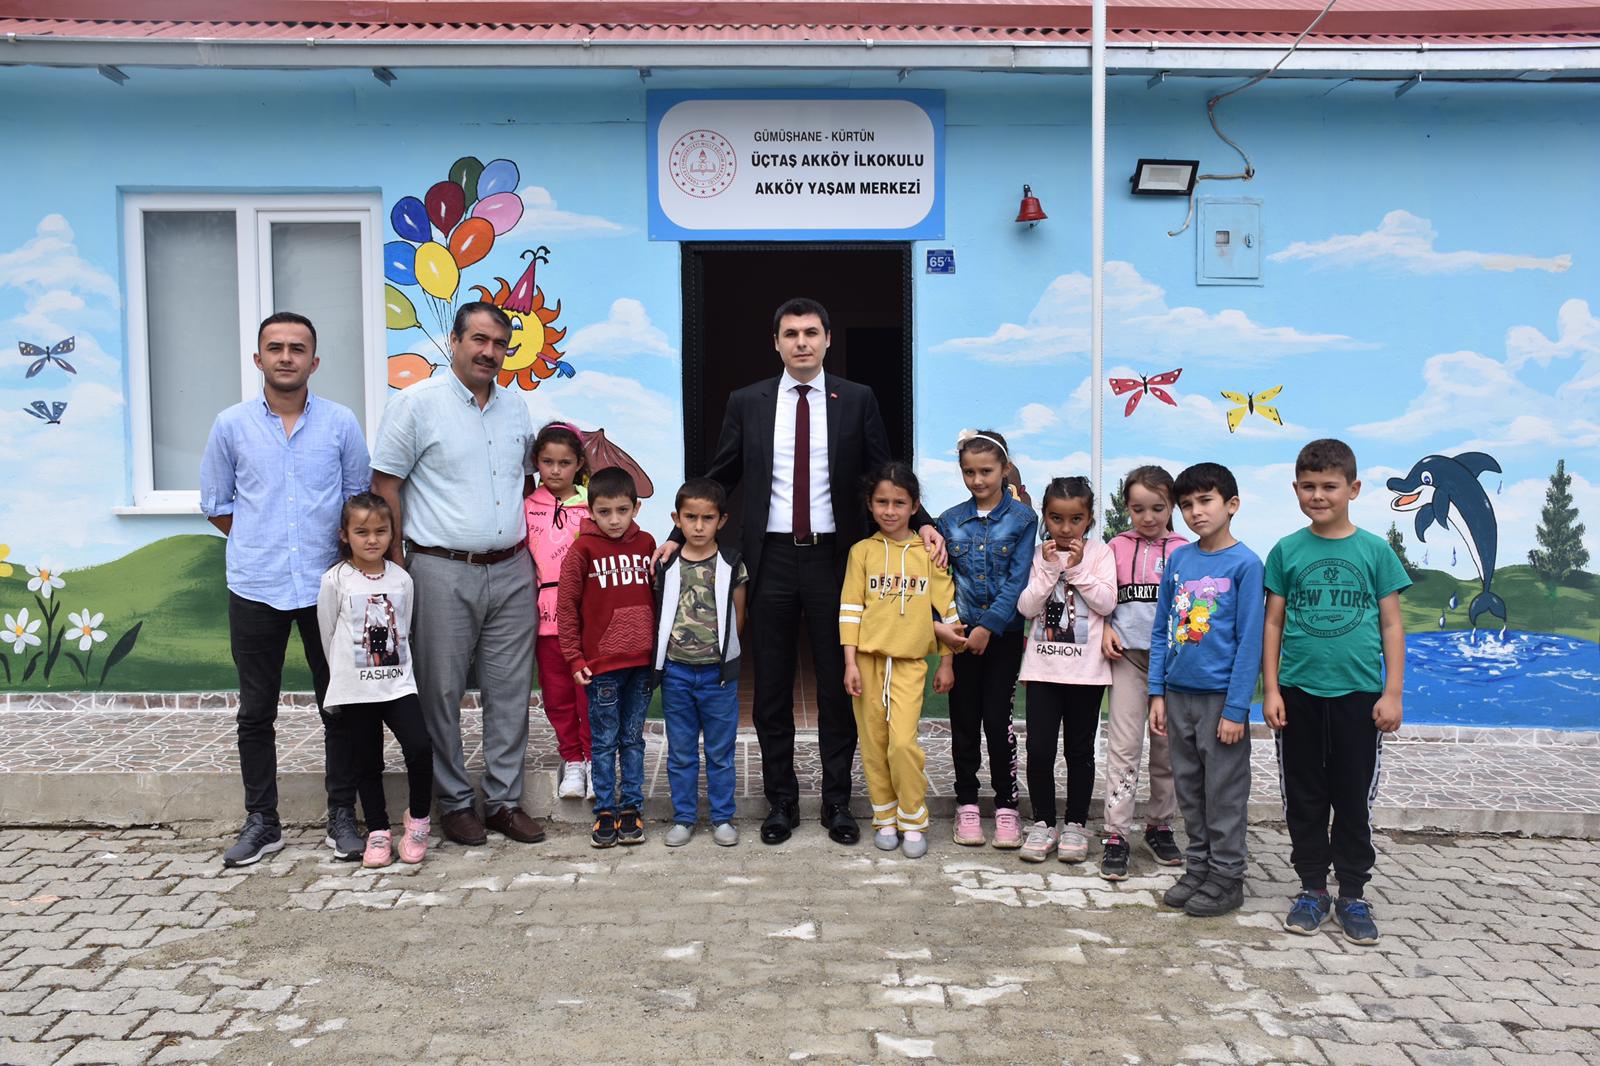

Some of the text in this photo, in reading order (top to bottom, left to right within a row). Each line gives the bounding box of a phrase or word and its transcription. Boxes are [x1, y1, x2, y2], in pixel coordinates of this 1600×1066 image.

[754, 128, 822, 143] GÜMÜŞHANE
[832, 128, 875, 142] KÜRTÜN
[752, 150, 924, 168] ÜÇTAŞ AKKÖY İLKOKULU
[755, 178, 920, 196] AKKÖY YAŞAM MERKEZİ
[870, 576, 926, 591] DESTROY
[1288, 589, 1373, 609] NEW YORK
[1036, 644, 1083, 657] FASHION
[360, 668, 404, 680] FASHION
